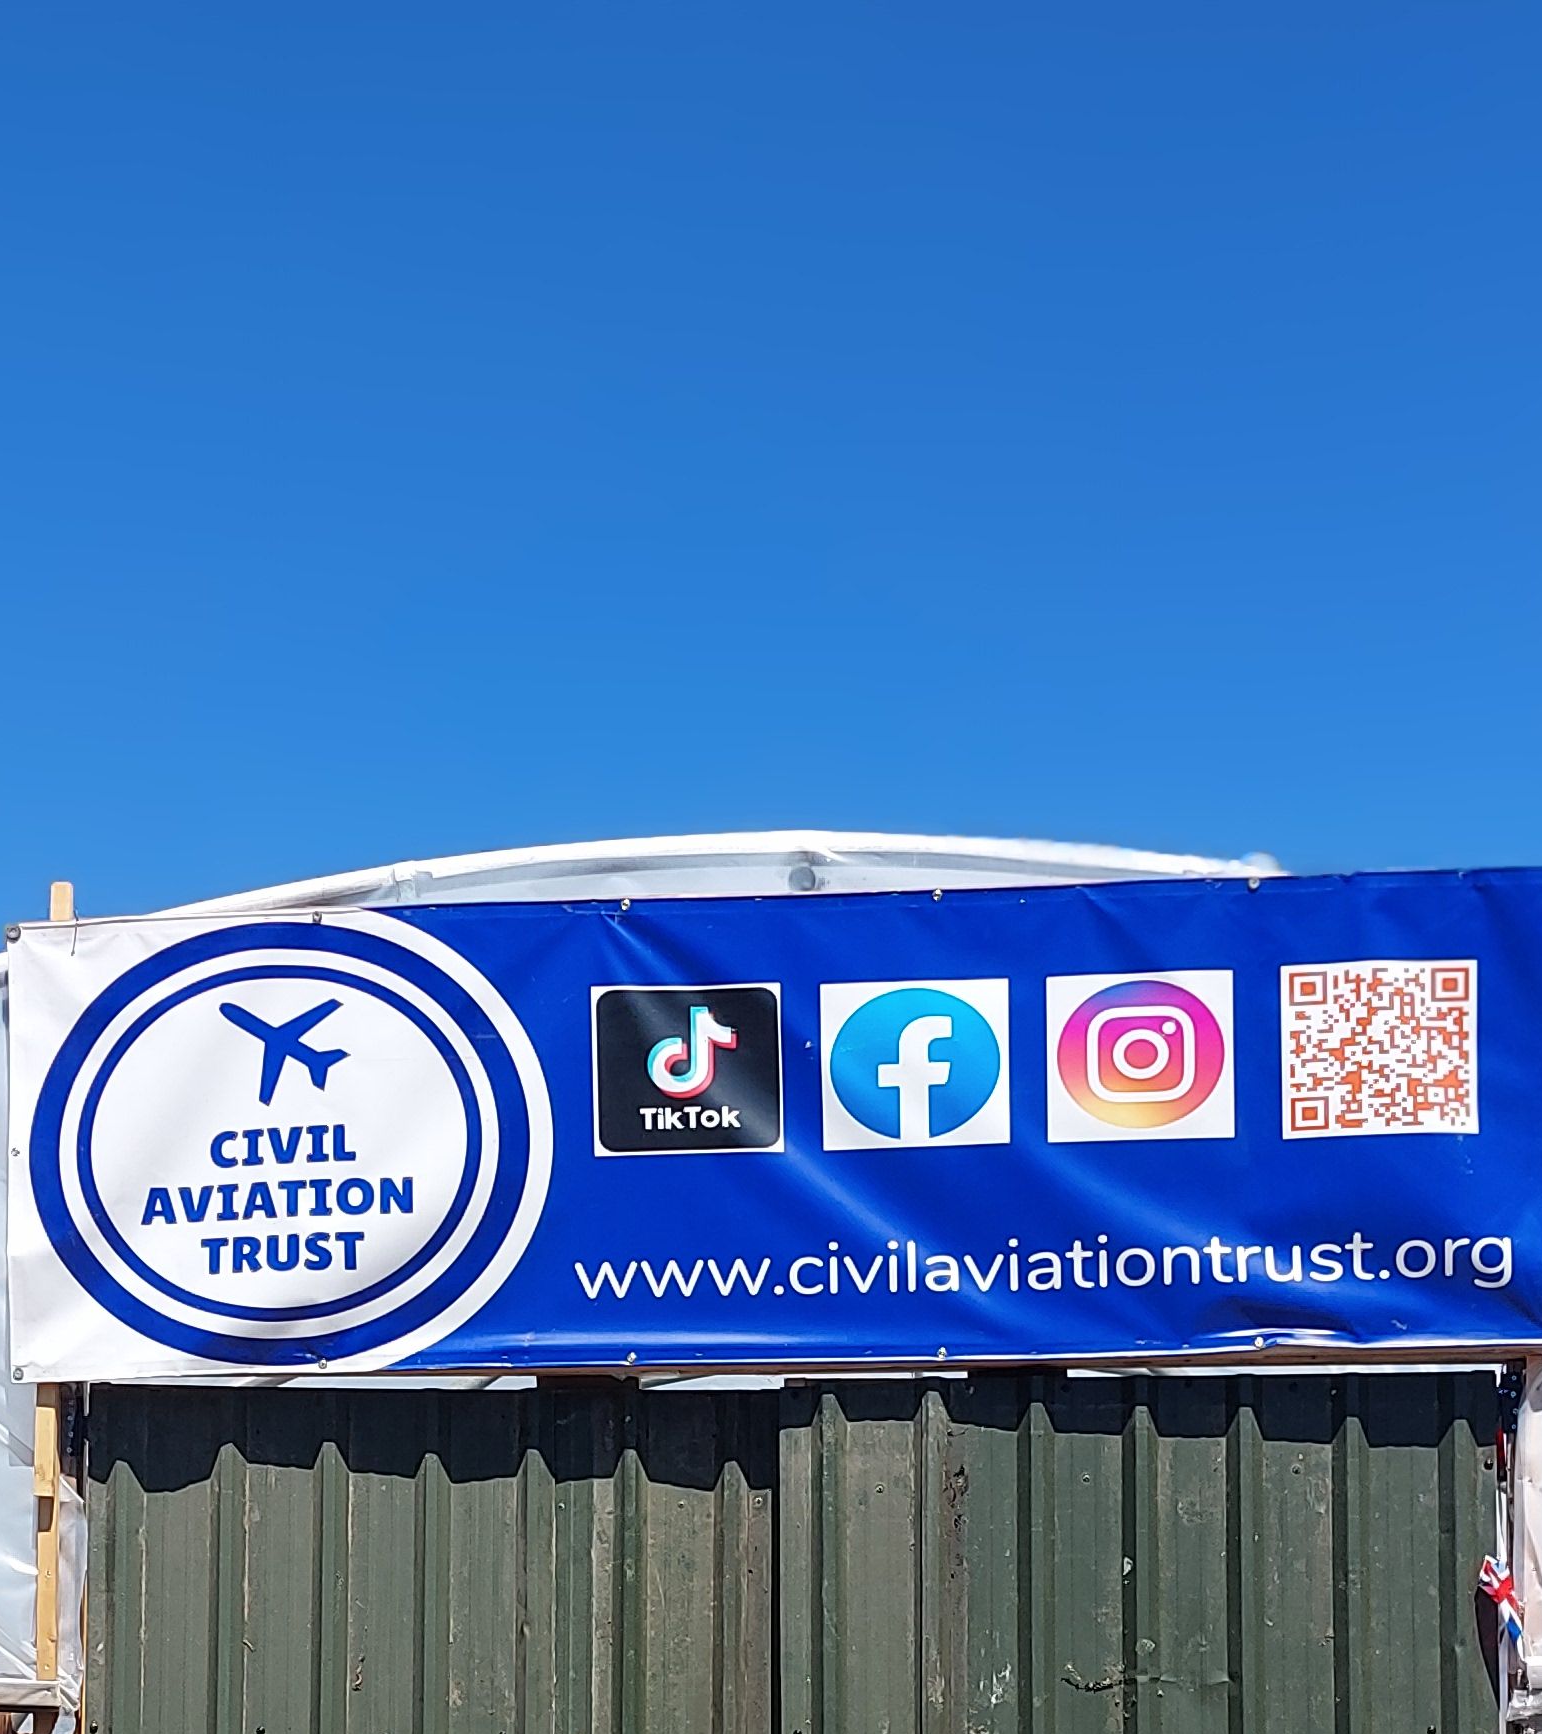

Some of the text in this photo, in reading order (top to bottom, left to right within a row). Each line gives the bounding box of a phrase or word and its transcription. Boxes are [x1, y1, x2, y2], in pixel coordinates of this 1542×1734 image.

[639, 1104, 742, 1131] TikTok
[210, 1123, 357, 1169] CIVIL
[141, 1176, 414, 1227] AVIATION
[201, 1231, 365, 1275] TRUST
[574, 1230, 1514, 1300] www.civilaviationtrust.org
